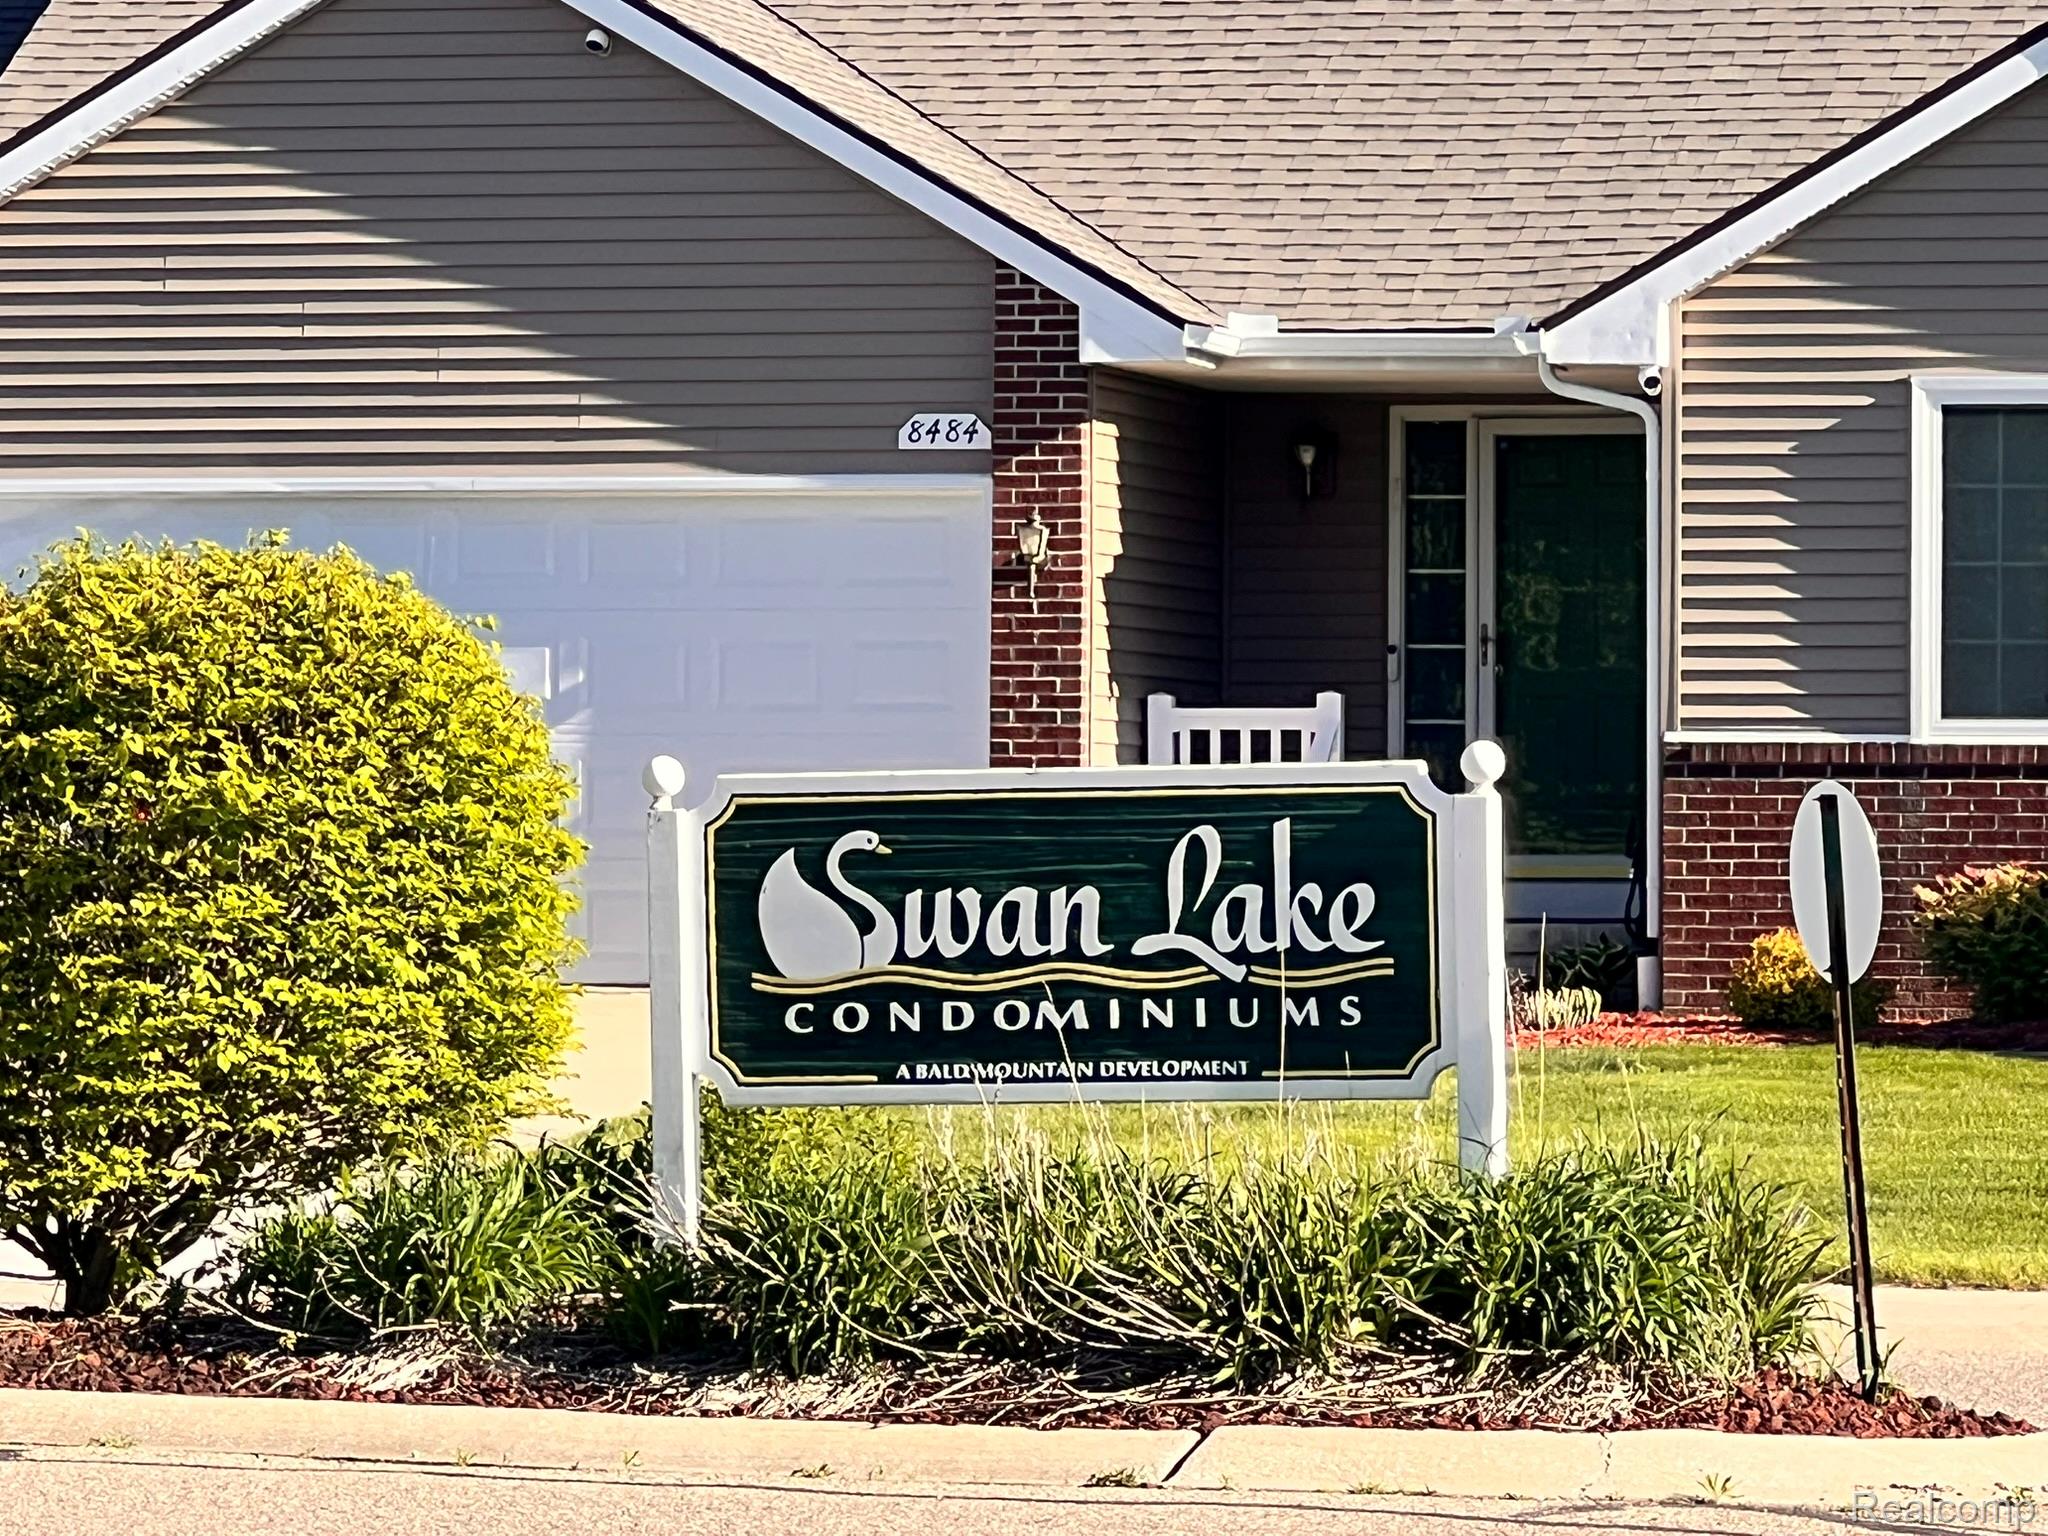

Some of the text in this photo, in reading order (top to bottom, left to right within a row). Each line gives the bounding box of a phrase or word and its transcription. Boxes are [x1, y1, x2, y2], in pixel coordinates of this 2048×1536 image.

[907, 418, 979, 445] 8484
[826, 817, 1386, 983] Swan Lake
[784, 995, 1362, 1033] CONDOMINIUMS
[896, 1063, 911, 1080] A
[915, 1063, 972, 1079] BALD
[1100, 1060, 1249, 1077] DEVELOPMENT
